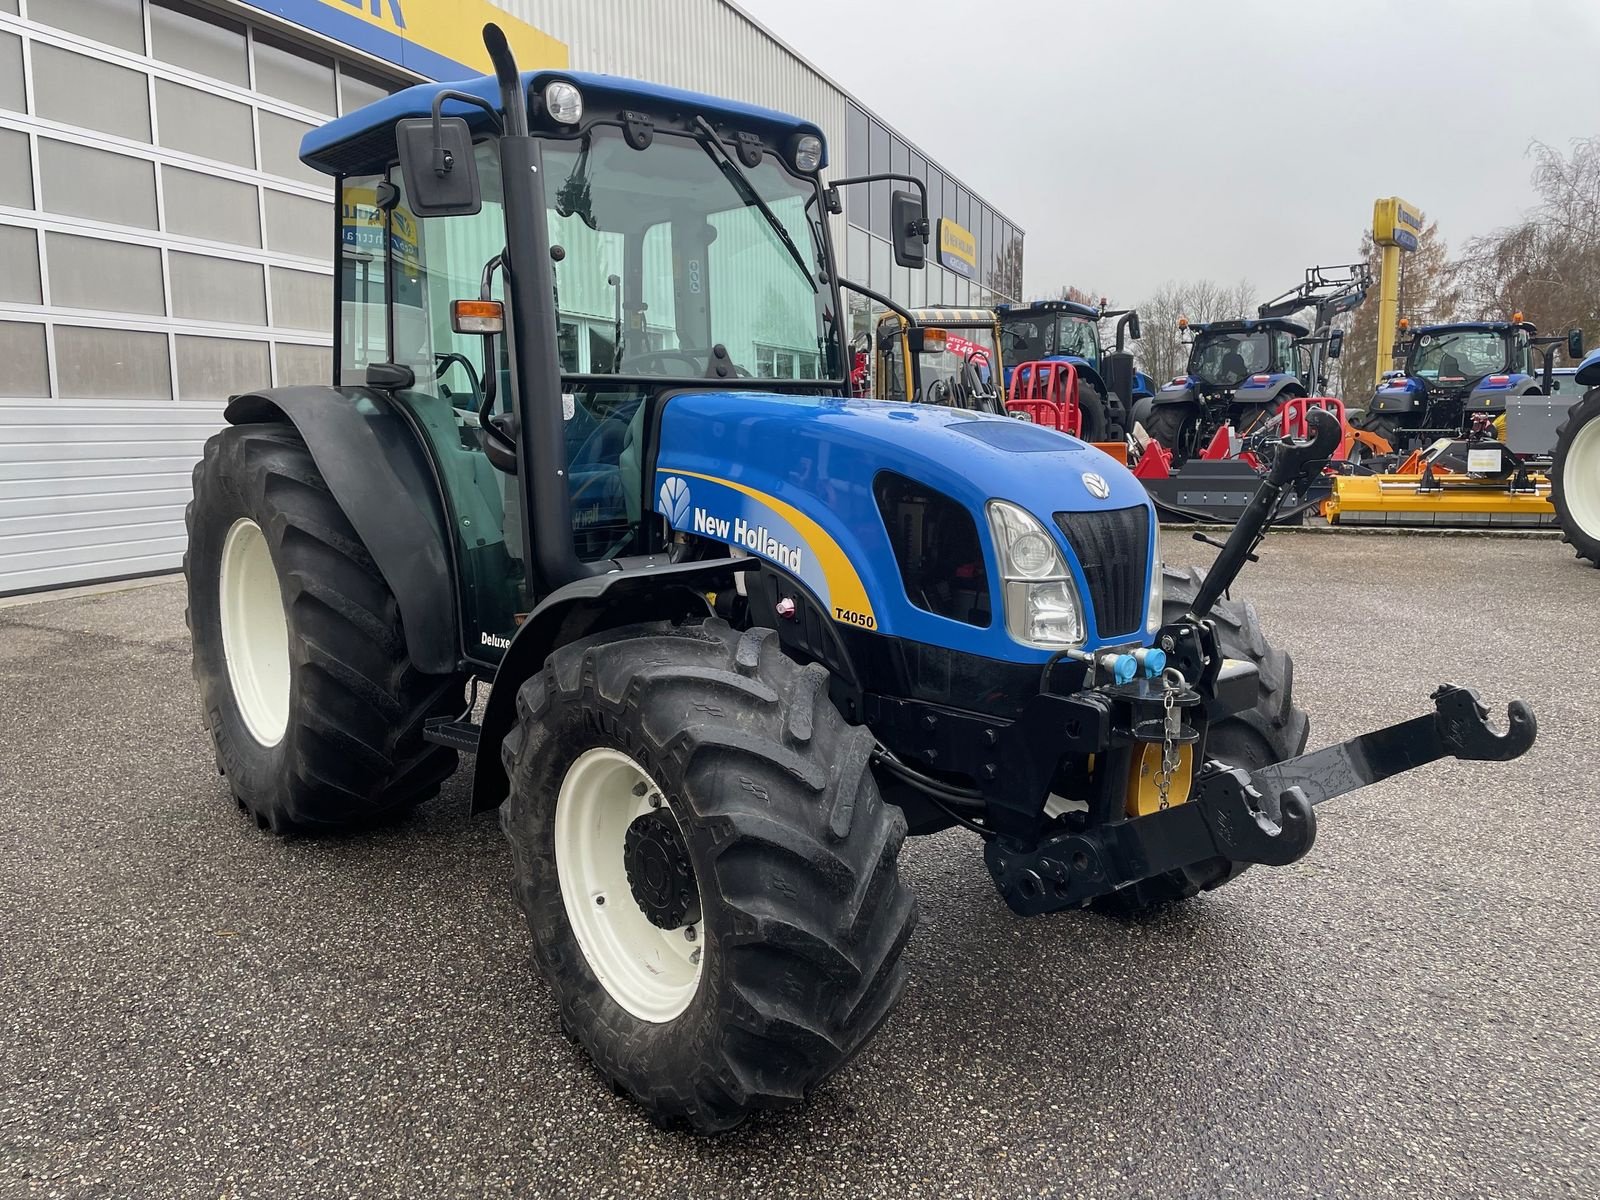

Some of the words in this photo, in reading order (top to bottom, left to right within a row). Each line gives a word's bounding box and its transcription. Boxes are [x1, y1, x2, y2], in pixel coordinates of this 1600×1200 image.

[694, 507, 731, 539] New
[734, 518, 802, 574] Holland
[835, 607, 874, 628] T4050
[481, 631, 511, 649] Deluxe
